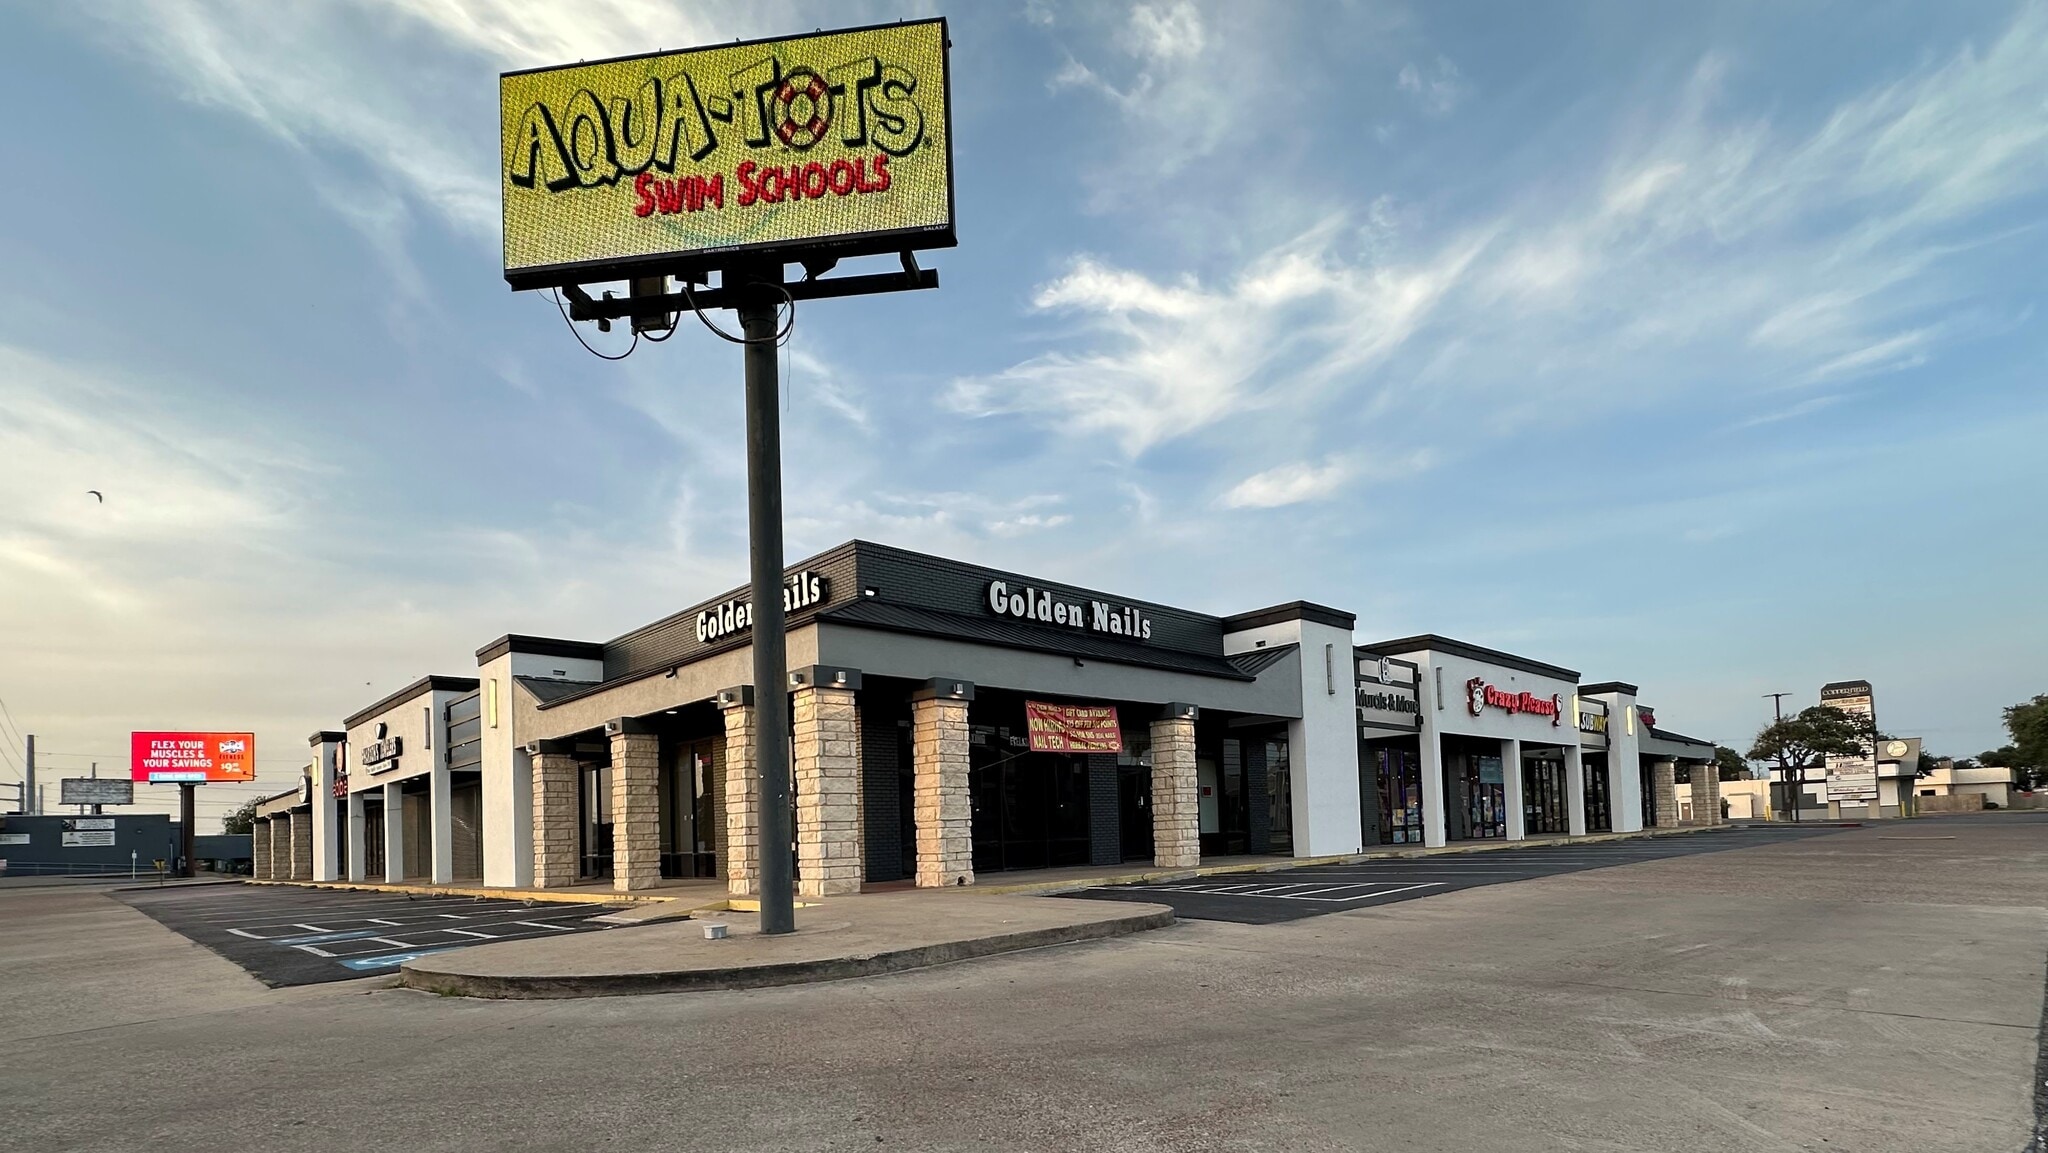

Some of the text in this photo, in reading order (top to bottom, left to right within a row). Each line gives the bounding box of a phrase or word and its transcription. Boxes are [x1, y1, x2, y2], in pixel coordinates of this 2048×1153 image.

[510, 56, 925, 192] AQUA-TOTS
[634, 153, 892, 218] SWIM SCHOOLS
[784, 570, 821, 612] ails
[989, 580, 1151, 639] Golden Nails
[1387, 693, 1396, 711] &
[1395, 694, 1420, 714] More
[1487, 685, 1556, 716] Crazy Picasso
[1580, 712, 1609, 733] SUBWAY
[150, 749, 205, 758] MUSCLES &
[151, 740, 204, 749] FLEX YOUR
[142, 759, 213, 768] YOUR SAVINGS
